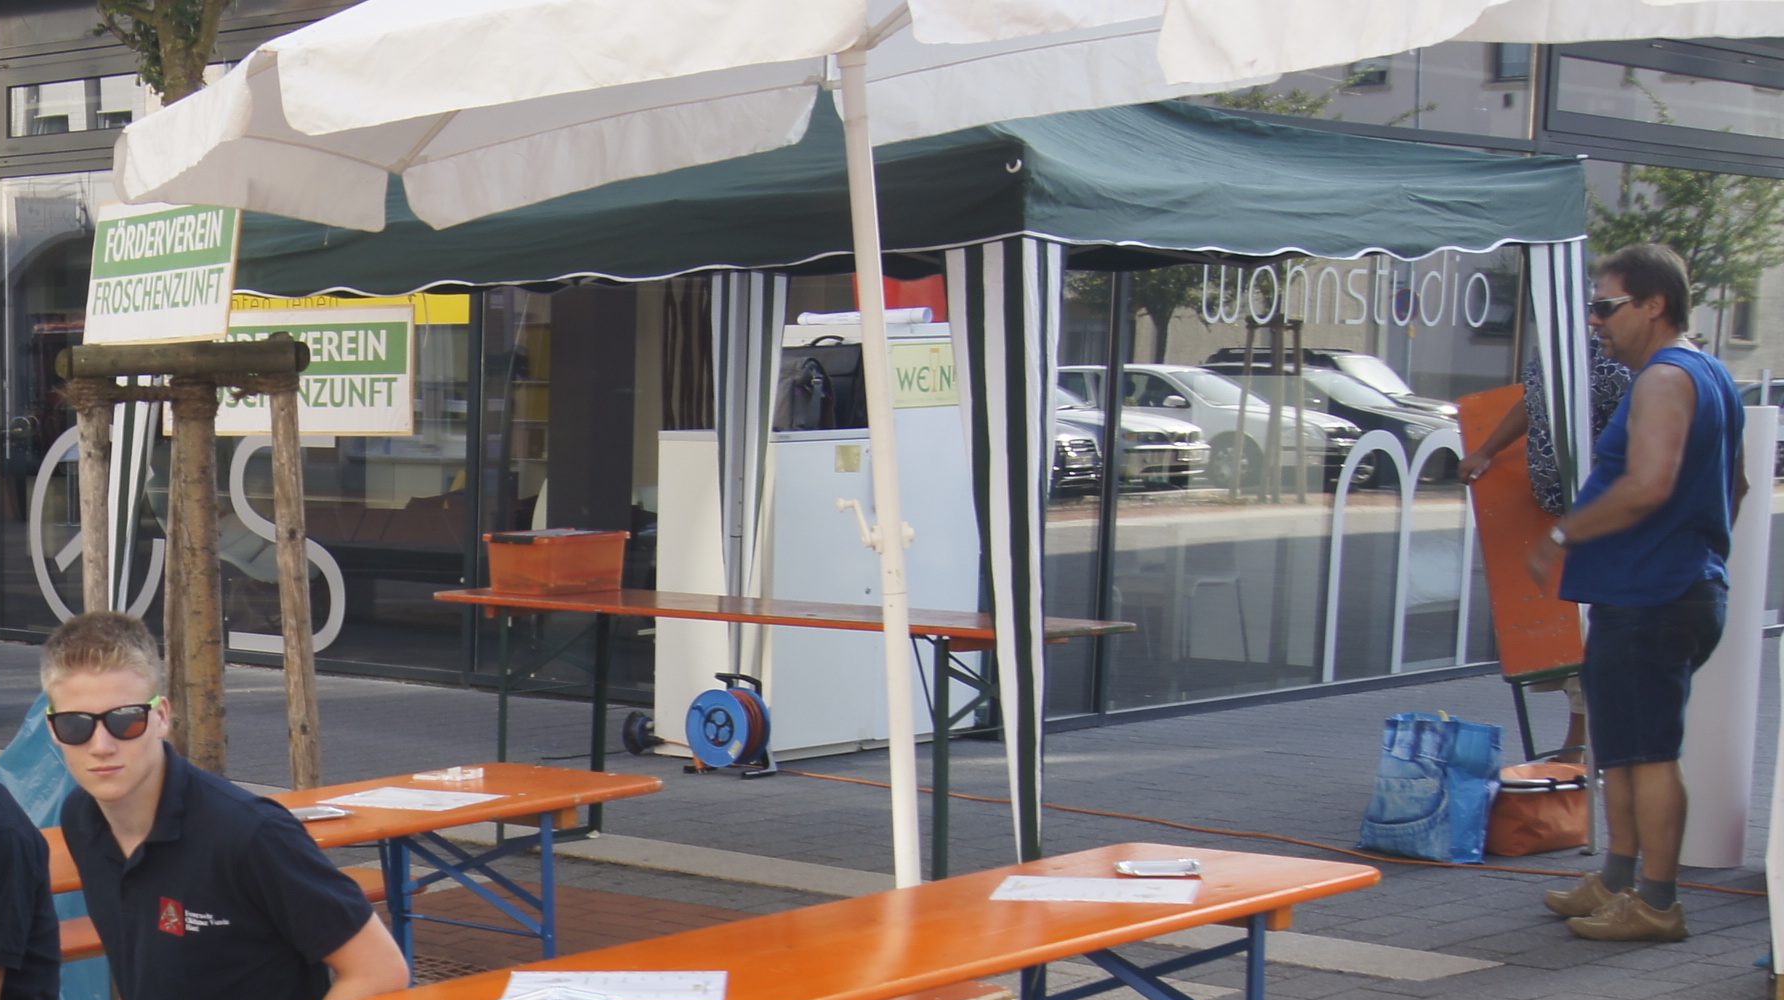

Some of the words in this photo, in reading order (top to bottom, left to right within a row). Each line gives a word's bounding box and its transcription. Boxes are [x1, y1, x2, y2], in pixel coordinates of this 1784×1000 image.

[103, 208, 224, 263] FÖRDERVEREIN
[91, 266, 225, 316] FROSCHENZUNFT
[1202, 248, 1490, 328] wohnstudio
